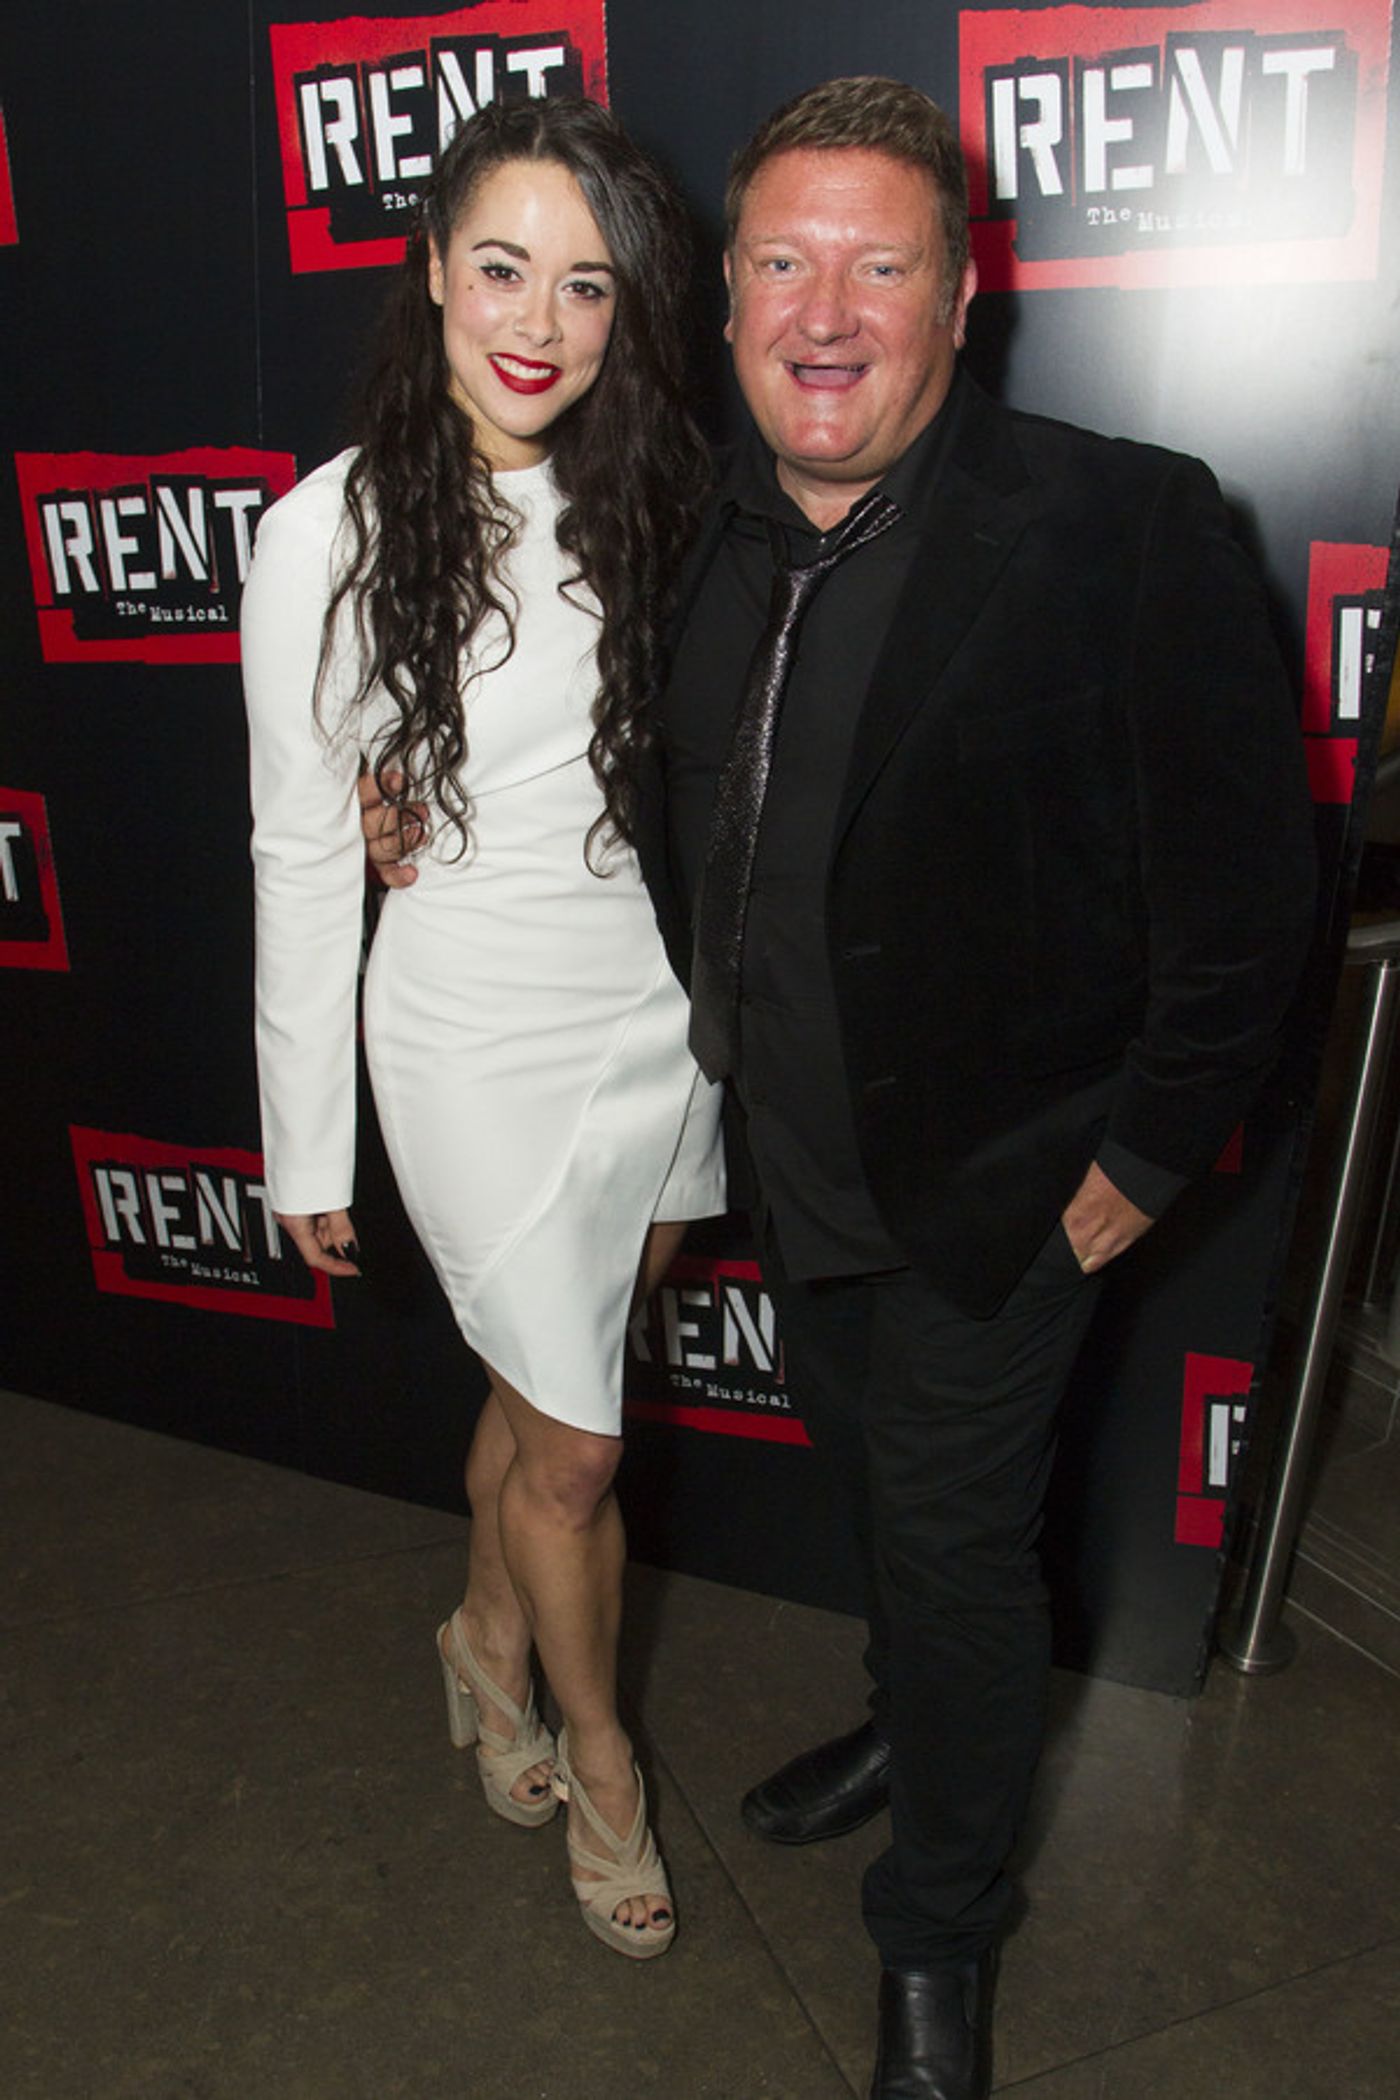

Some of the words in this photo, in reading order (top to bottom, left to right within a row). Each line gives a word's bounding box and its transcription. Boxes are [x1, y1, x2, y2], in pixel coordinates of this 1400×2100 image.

[992, 46, 1336, 200] RENT
[1087, 206, 1131, 226] The
[42, 486, 262, 595] RENT
[117, 602, 146, 616] The
[150, 605, 229, 623] Musical
[94, 1168, 282, 1261] RENT
[161, 1254, 188, 1269] The
[191, 1261, 261, 1286] Musical
[669, 1374, 703, 1389] The
[706, 1382, 793, 1409] Musical
